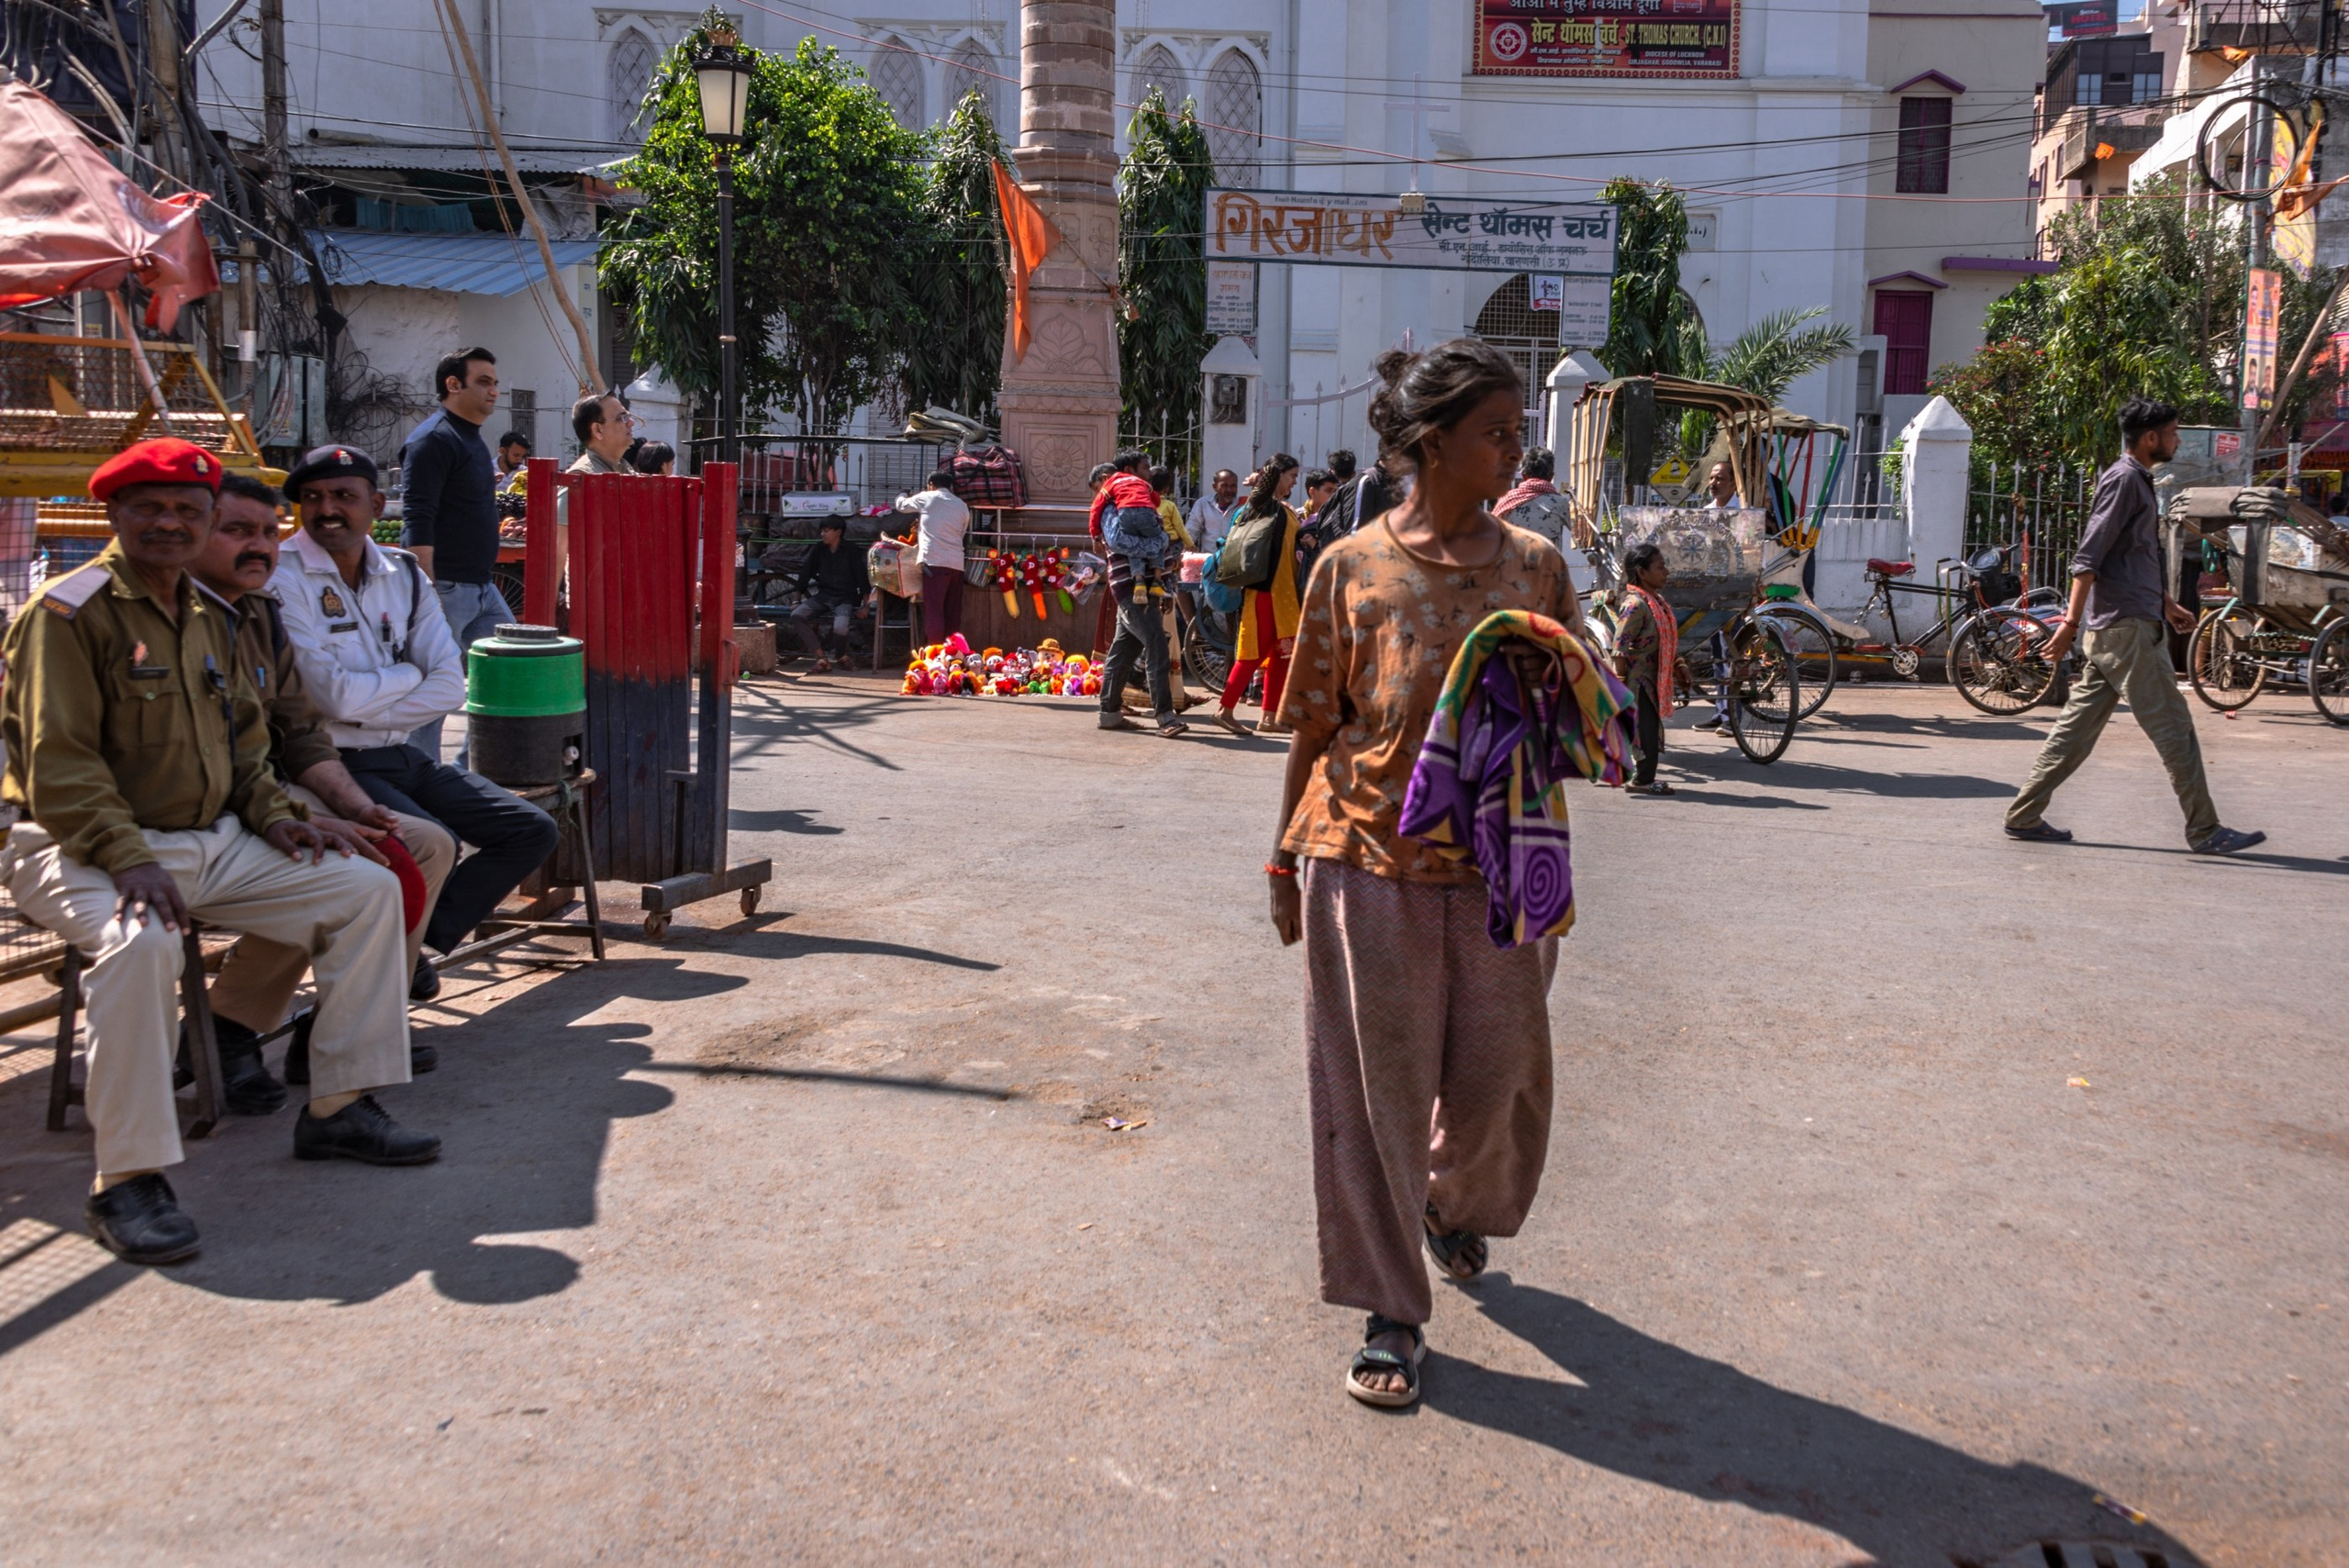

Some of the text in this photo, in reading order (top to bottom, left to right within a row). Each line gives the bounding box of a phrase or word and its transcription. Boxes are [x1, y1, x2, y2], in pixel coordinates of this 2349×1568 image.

[1598, 17, 1620, 44] चर्च
[2071, 12, 2109, 24] HOTEL
[1625, 24, 1637, 45] ST.
[1638, 24, 1669, 45] THOMAS
[1213, 192, 1403, 261] गिरजाघर
[1421, 202, 1611, 242] सेन्ट थॉमस चर्च
